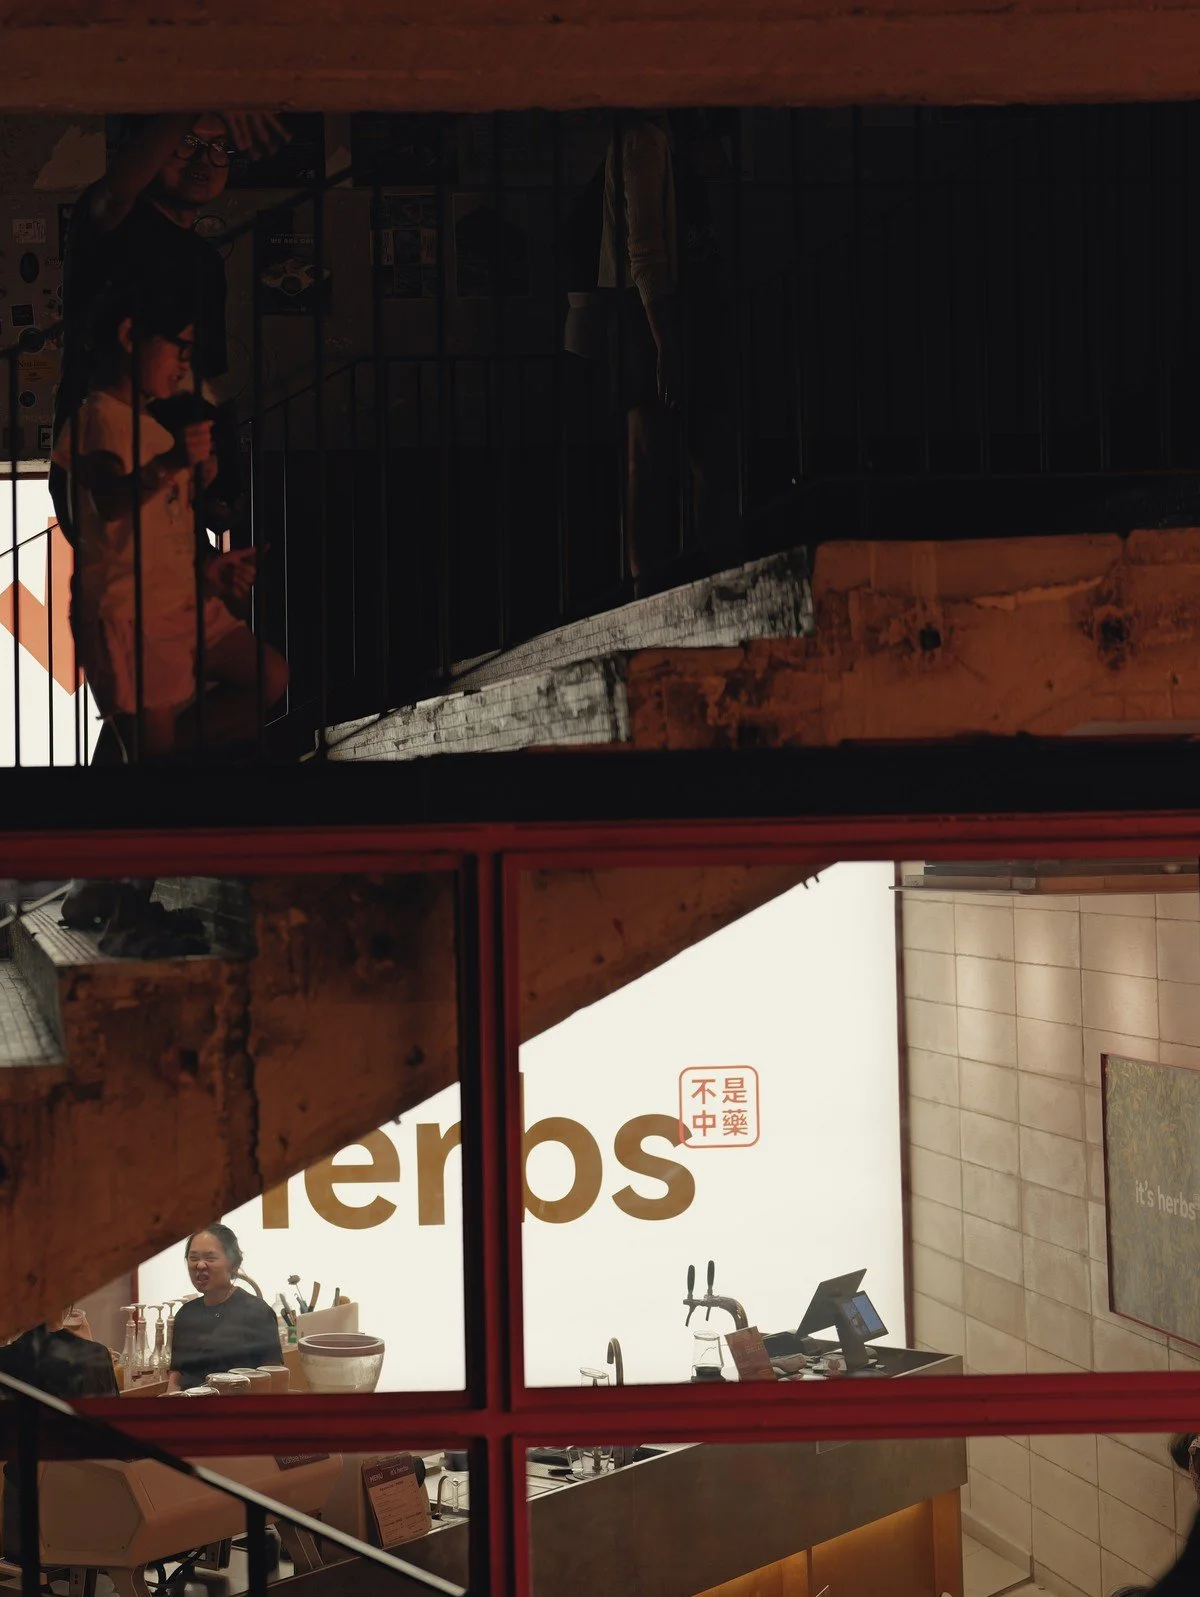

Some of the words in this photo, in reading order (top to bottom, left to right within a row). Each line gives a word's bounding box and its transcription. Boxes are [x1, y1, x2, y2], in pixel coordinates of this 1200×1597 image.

[691, 1077, 748, 1105] 不是
[691, 1108, 748, 1137] 中藥
[1157, 1185, 1197, 1221] herbs
